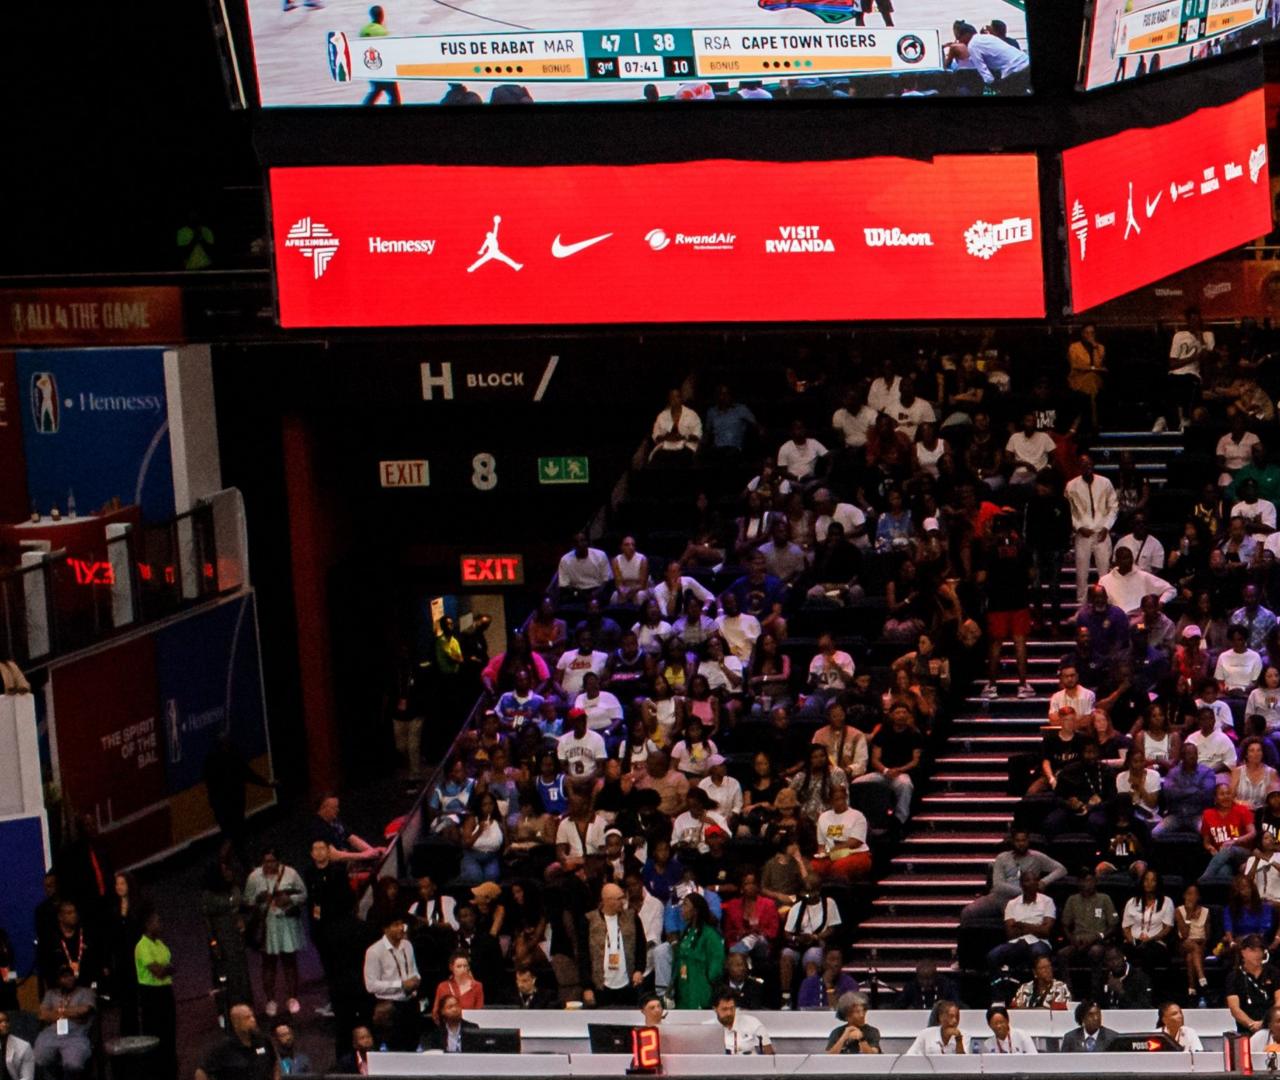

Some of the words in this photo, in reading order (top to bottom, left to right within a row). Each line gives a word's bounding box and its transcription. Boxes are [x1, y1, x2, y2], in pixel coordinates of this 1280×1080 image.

[441, 42, 467, 56] FUS
[471, 42, 488, 55] DE
[491, 41, 534, 54] RABAT
[544, 40, 574, 53] MAR
[602, 34, 620, 52] 47
[653, 34, 675, 51] 38
[703, 36, 731, 50] RSA
[741, 36, 778, 50] CAPE
[781, 35, 822, 49] TOWN
[826, 34, 876, 48] TIGERS
[542, 65, 571, 74] BONUS
[596, 62, 613, 75] 3rd
[624, 61, 658, 73] 07:41
[673, 60, 688, 74] 10
[709, 60, 740, 71] BONUS
[675, 232, 736, 246] RwandAir
[779, 226, 819, 239] VISIT
[863, 228, 933, 247] Wilson
[285, 239, 339, 247] AFREXIMBANK
[368, 236, 435, 254] Hennessy
[766, 240, 835, 253] RWANDA
[70, 302, 99, 329] THE
[102, 301, 150, 329] GAME
[420, 361, 454, 400] H
[466, 372, 525, 388] BLOCK
[79, 392, 162, 412] Hennessy
[385, 462, 425, 485] EXIT
[471, 452, 498, 491] 8
[462, 558, 518, 581] EXIT
[102, 733, 122, 750] THE
[123, 717, 155, 744] SPIRIT
[121, 744, 135, 759] OF
[136, 735, 158, 754] THE
[138, 754, 158, 769] BAL
